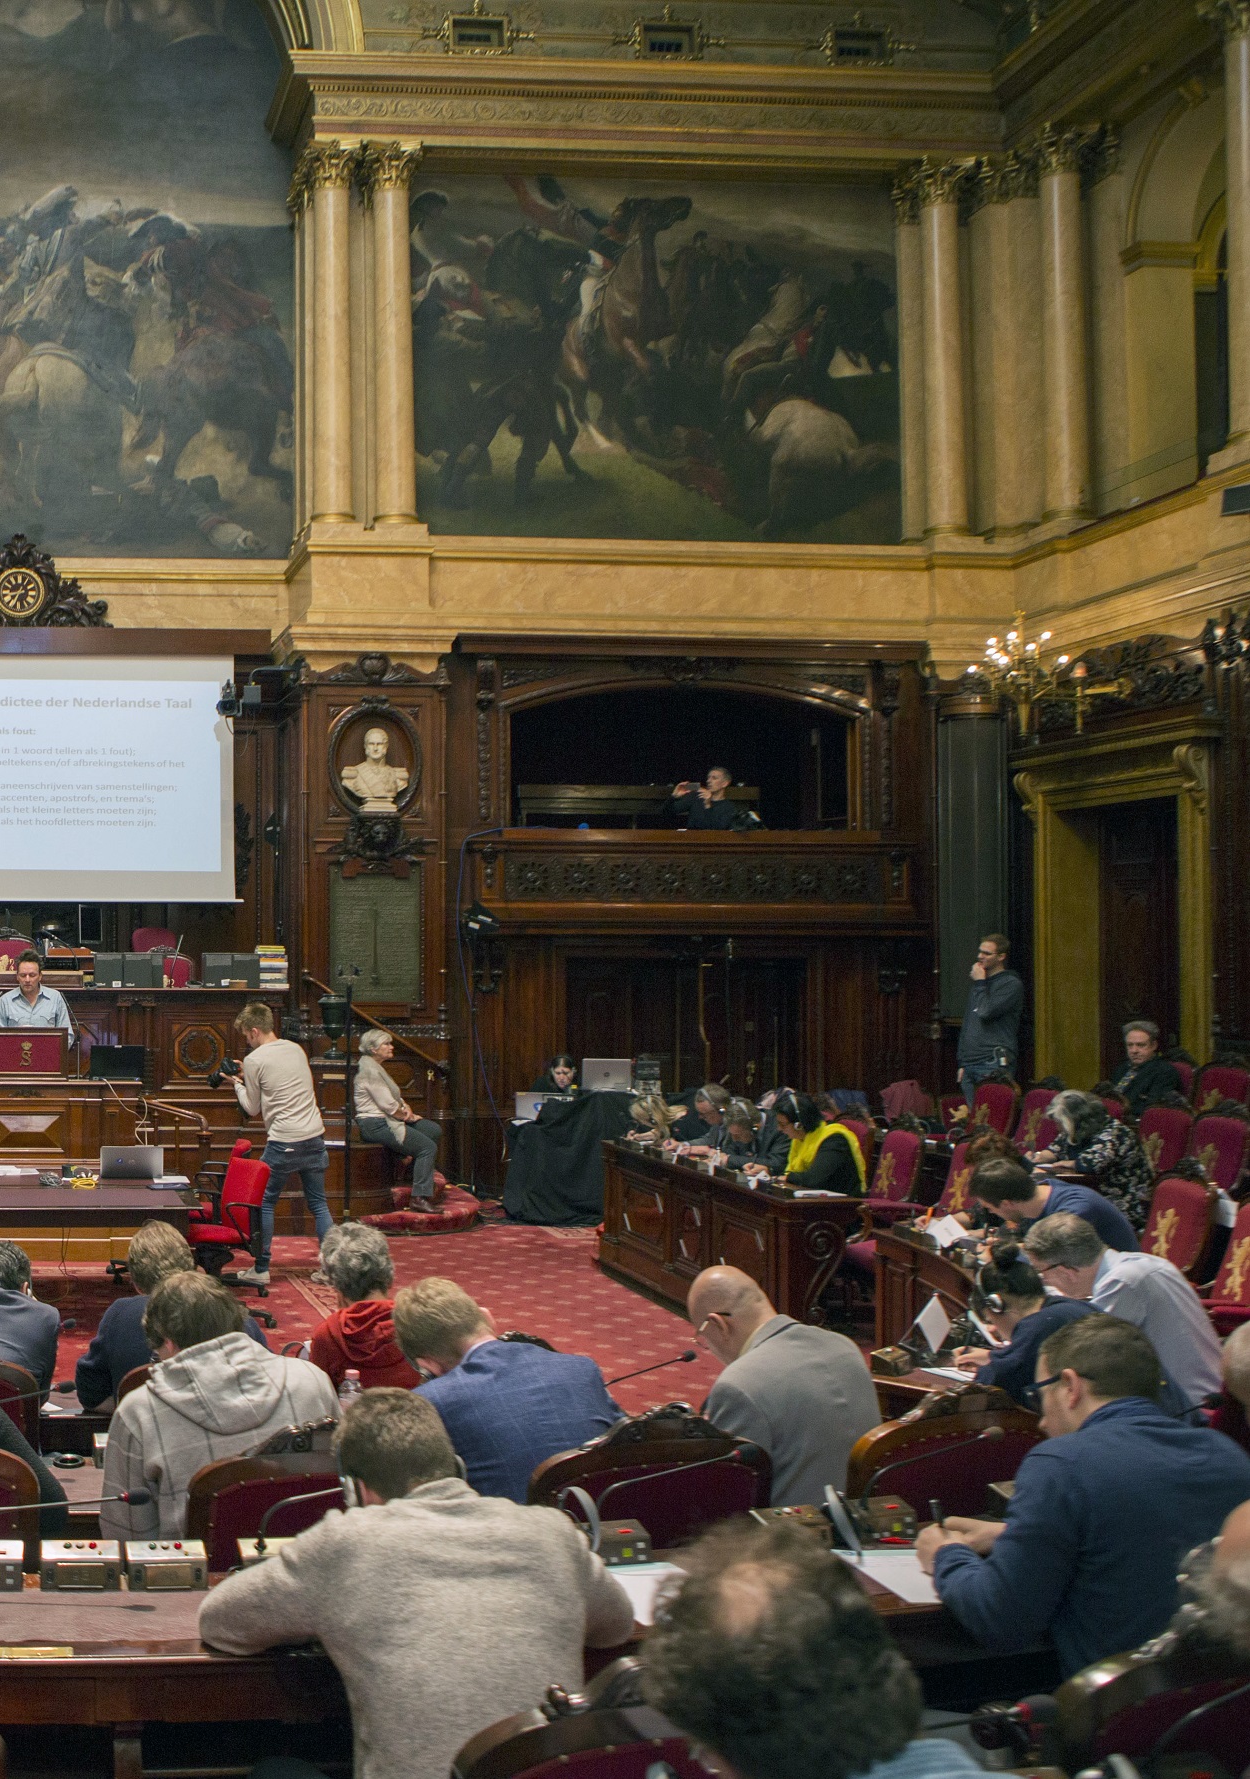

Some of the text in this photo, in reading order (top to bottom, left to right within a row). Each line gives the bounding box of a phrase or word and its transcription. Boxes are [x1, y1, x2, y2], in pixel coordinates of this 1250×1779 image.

[46, 698, 69, 707] der
[72, 698, 160, 708] Nederlandse
[164, 699, 192, 709] Taal
[13, 726, 36, 735] fout:
[22, 747, 52, 755] woord
[55, 747, 81, 755] tellen
[85, 747, 97, 755] als
[109, 747, 136, 757] fout);
[44, 759, 70, 768] en/of
[168, 760, 185, 768] het
[96, 783, 177, 792] samenstellingen;
[0, 795, 47, 803] accenten,
[50, 794, 98, 804] apostrofs,
[115, 795, 154, 804] trema's;
[14, 805, 29, 813] het
[32, 806, 61, 814] kleine
[64, 806, 94, 814] letters
[137, 807, 156, 816] zijn;
[0, 817, 13, 825] als
[16, 817, 32, 825] het
[36, 818, 94, 826] hoofdletters
[97, 819, 134, 827] moeten
[137, 819, 156, 828] zijn.
